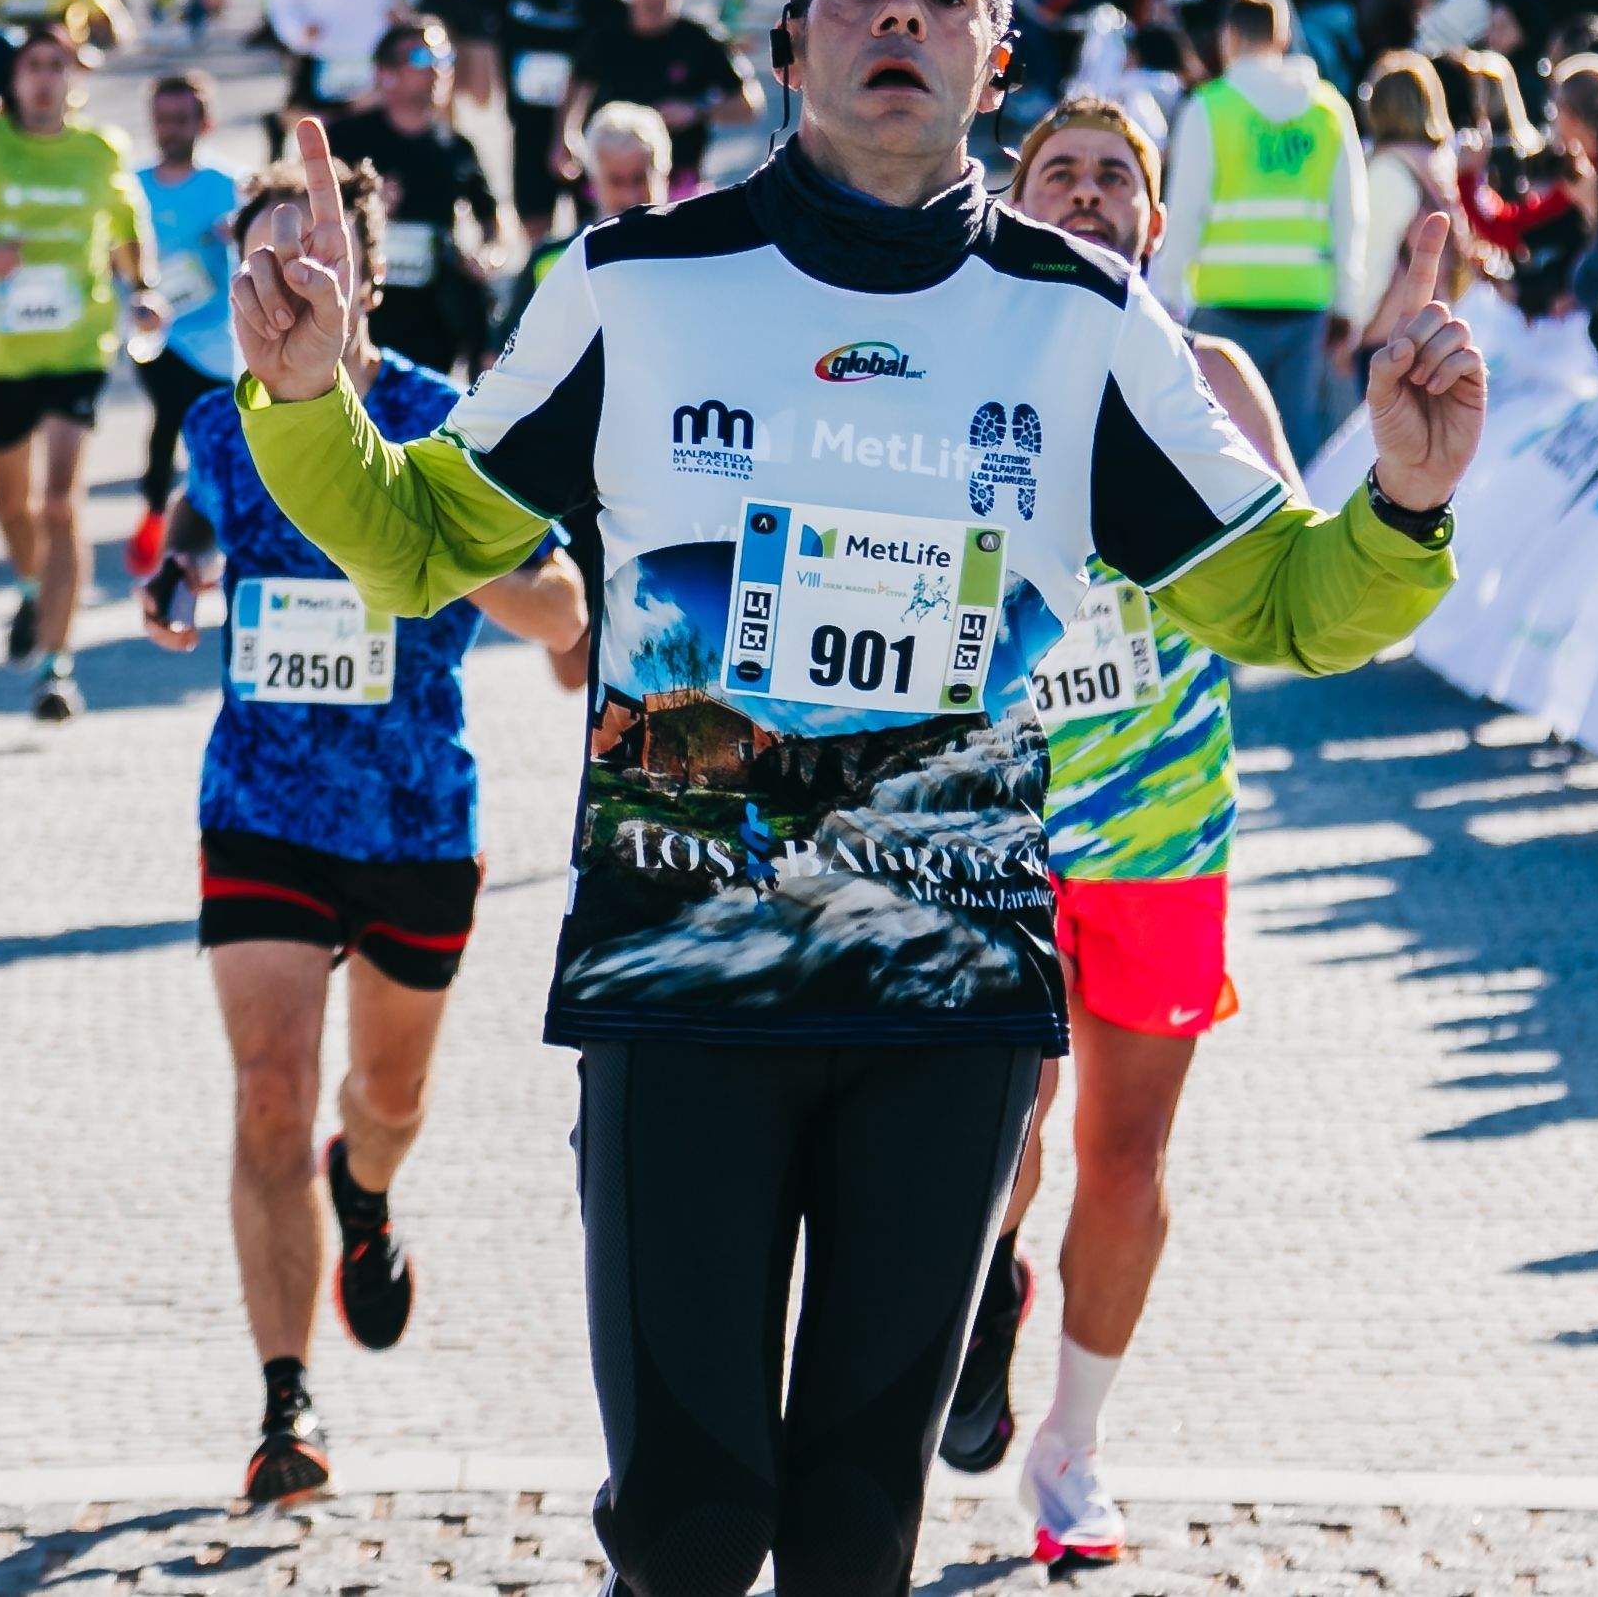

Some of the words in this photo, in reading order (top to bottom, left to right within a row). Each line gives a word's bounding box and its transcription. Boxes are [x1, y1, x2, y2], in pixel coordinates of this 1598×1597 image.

[1031, 262, 1078, 273] RUNNEK
[829, 350, 910, 379] global
[673, 448, 753, 465] MALPARTIDA
[673, 457, 687, 465] DE
[984, 453, 1031, 466] ATLETISMO
[981, 462, 1032, 476] MALPARTIDA
[971, 471, 990, 482] LOS
[991, 474, 1038, 487] BARRUECOS
[845, 534, 951, 568] MetLife
[796, 570, 821, 589] VIII
[808, 624, 916, 694] 901
[266, 652, 355, 691] 2850
[1032, 661, 1121, 712] 3150
[633, 819, 735, 878] LOS
